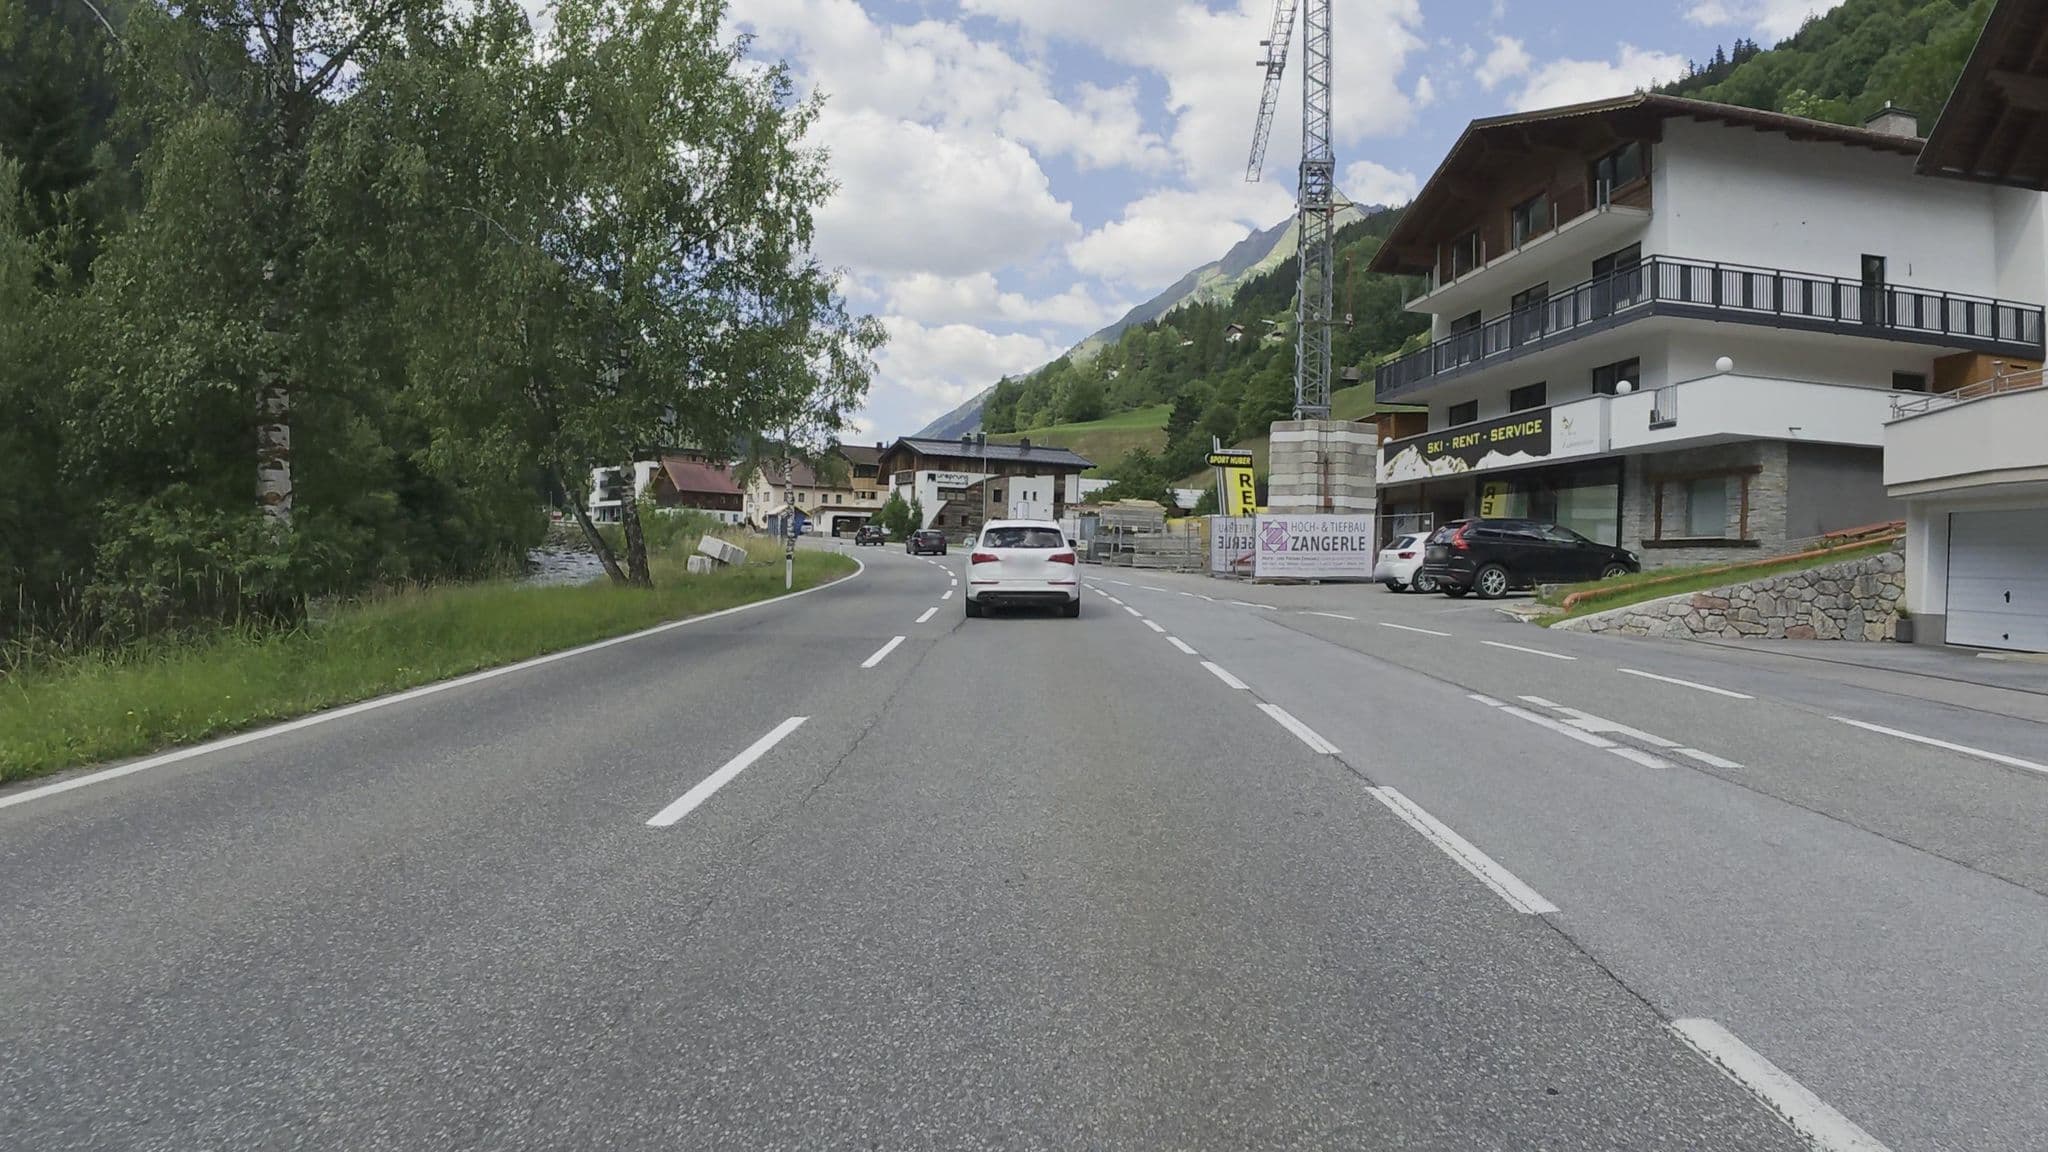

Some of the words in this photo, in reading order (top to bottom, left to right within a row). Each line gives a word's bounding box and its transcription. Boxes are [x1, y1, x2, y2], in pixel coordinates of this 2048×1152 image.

[1427, 440, 1443, 454] SKI
[1452, 433, 1480, 449] RENT
[1490, 419, 1542, 442] SERVICE
[1209, 455, 1230, 464] SPORT
[1230, 456, 1251, 465] HUBER
[1291, 521, 1320, 533] HOCH-
[1321, 521, 1329, 533] &
[1331, 521, 1366, 533] TIEFBAU
[1291, 536, 1366, 551] ZANGERLE
